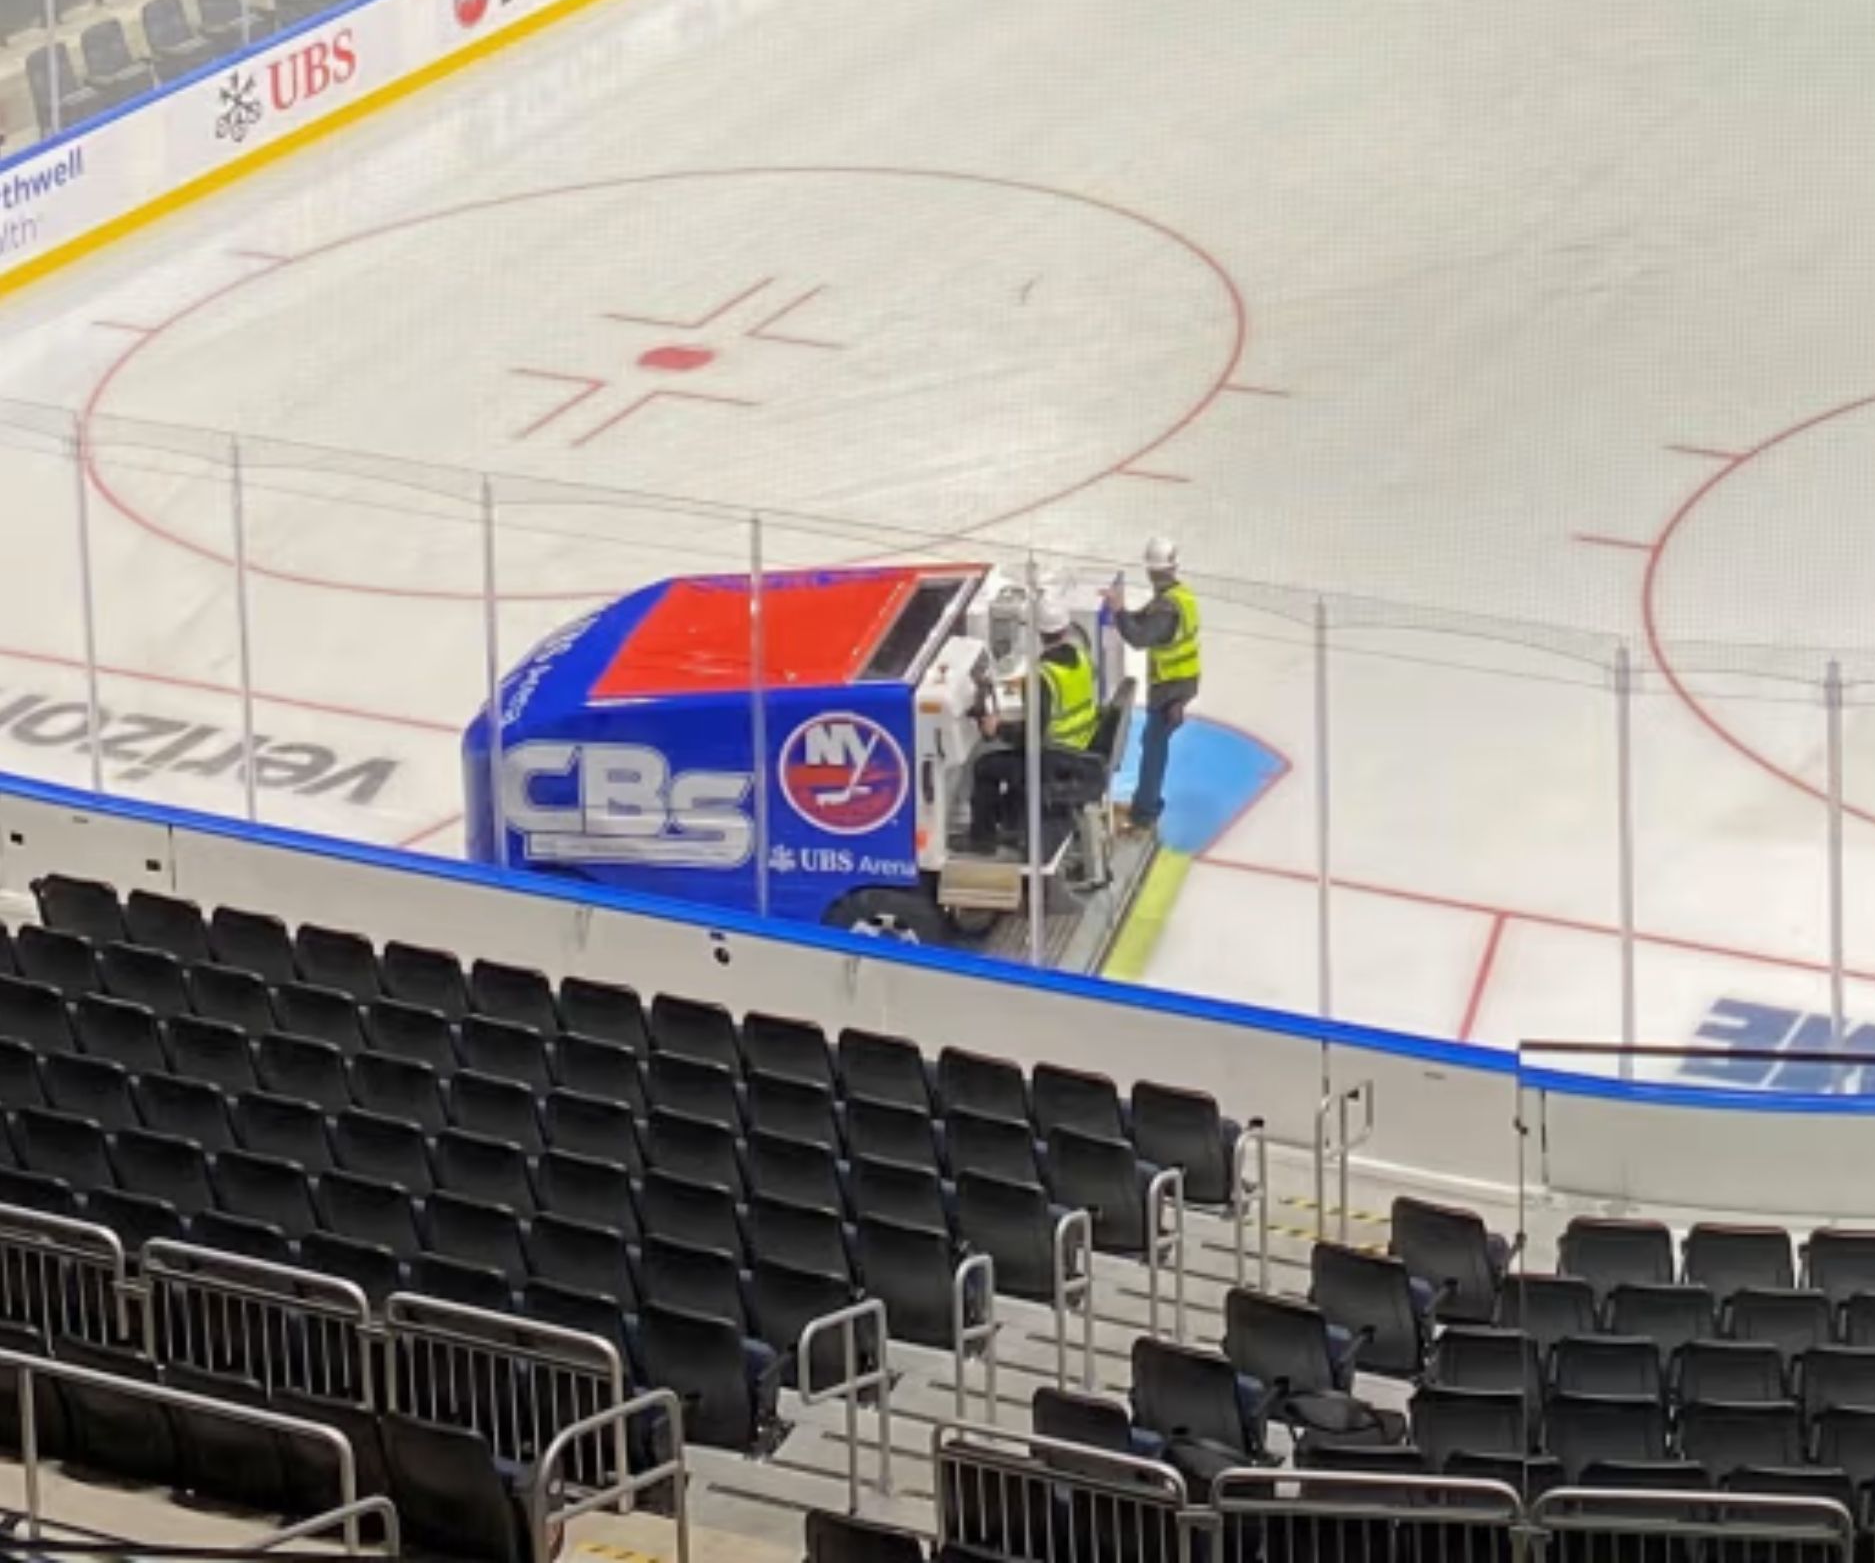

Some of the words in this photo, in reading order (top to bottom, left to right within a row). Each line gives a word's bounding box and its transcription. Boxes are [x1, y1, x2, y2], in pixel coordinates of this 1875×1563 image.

[267, 28, 357, 111] UBS
[0, 694, 400, 805] verizo
[801, 848, 854, 873] UBS
[859, 855, 917, 876] Arena
